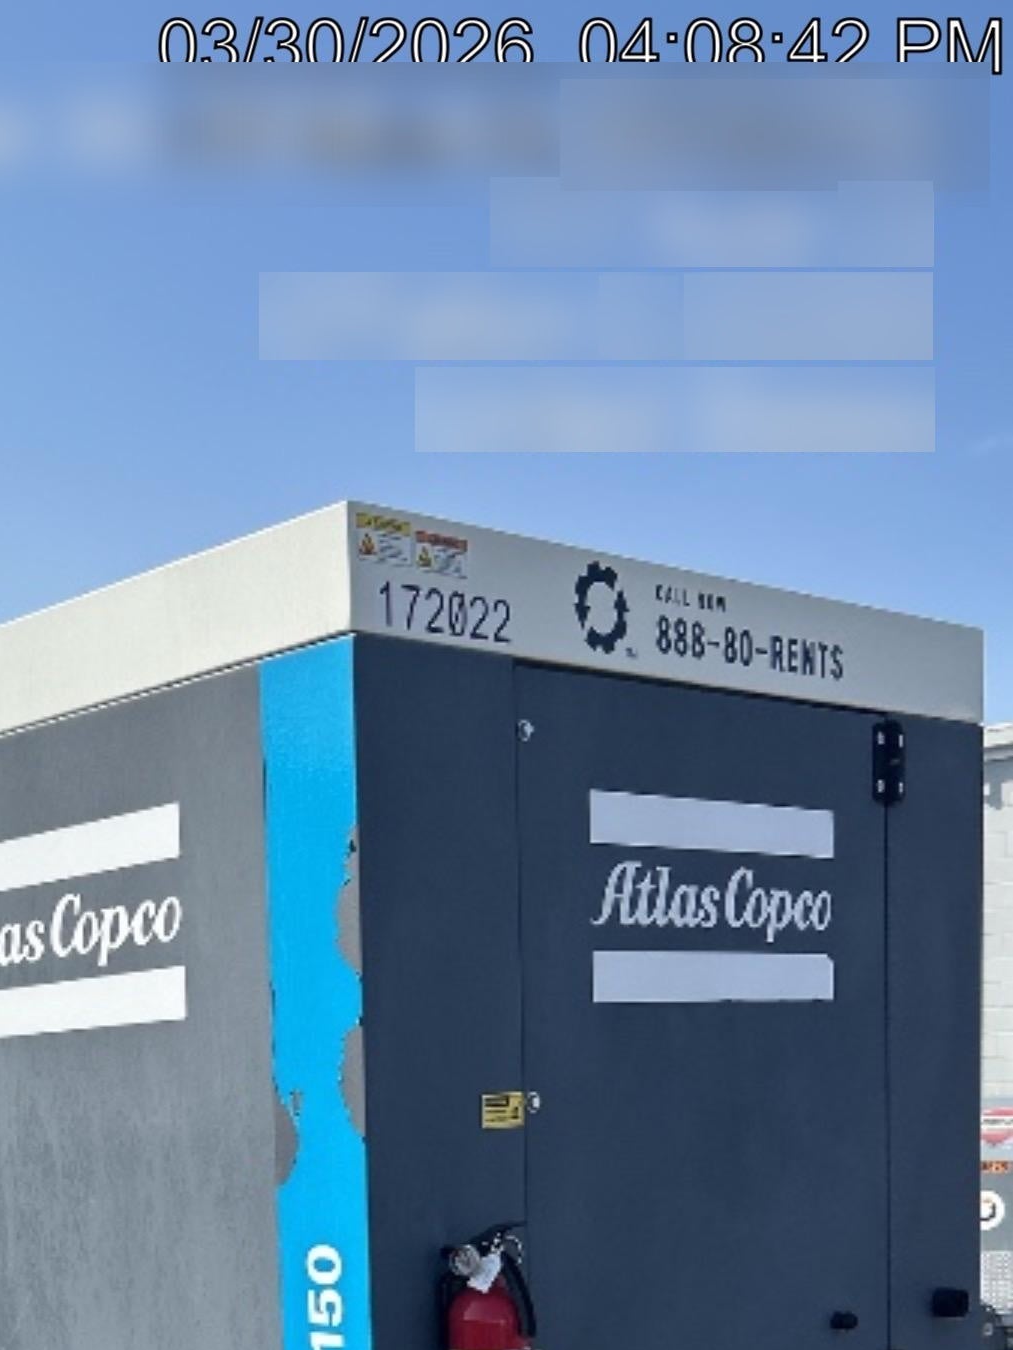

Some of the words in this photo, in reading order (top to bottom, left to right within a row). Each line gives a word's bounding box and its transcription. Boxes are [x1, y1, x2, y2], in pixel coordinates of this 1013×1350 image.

[379, 579, 512, 643] 172022
[655, 614, 844, 681] 888-80-RENTS
[50, 893, 183, 967] Copco
[590, 860, 721, 928] Atlas
[724, 866, 832, 944] Copco
